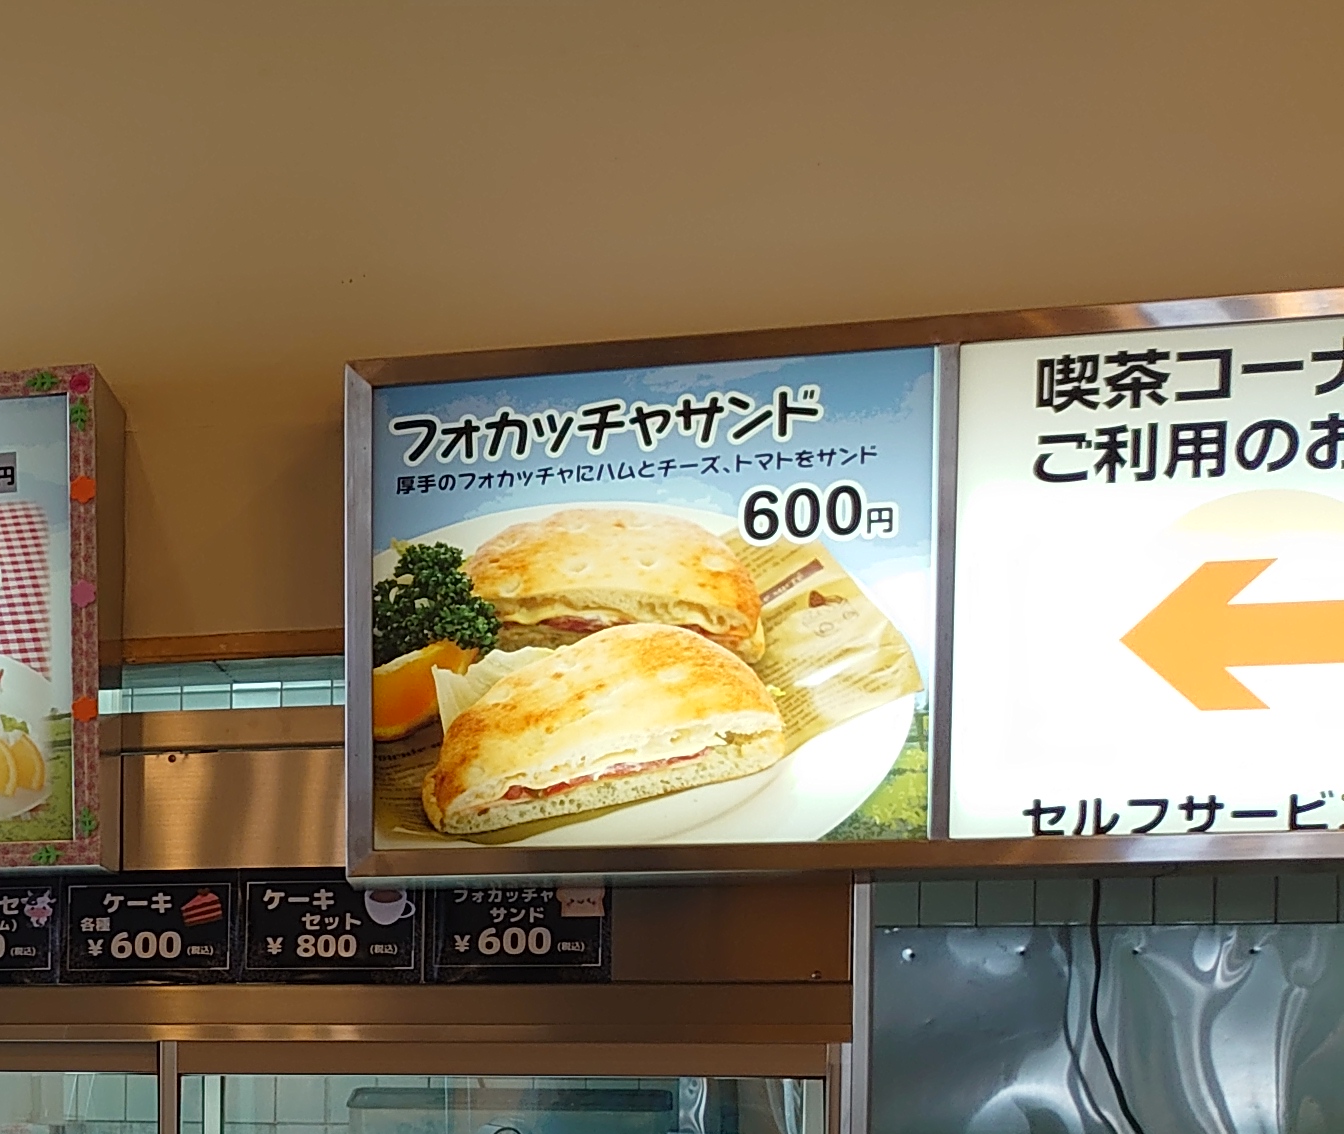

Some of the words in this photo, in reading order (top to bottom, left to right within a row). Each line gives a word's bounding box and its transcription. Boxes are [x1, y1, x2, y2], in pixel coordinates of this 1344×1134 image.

[393, 389, 819, 460] フォカッチャサンド
[744, 486, 893, 541] 600円
[1023, 791, 1344, 836] セルフサービ
[103, 892, 172, 914] ケーキ
[263, 888, 335, 910] ケーキ
[301, 912, 362, 931] セット
[489, 907, 545, 923] サンド
